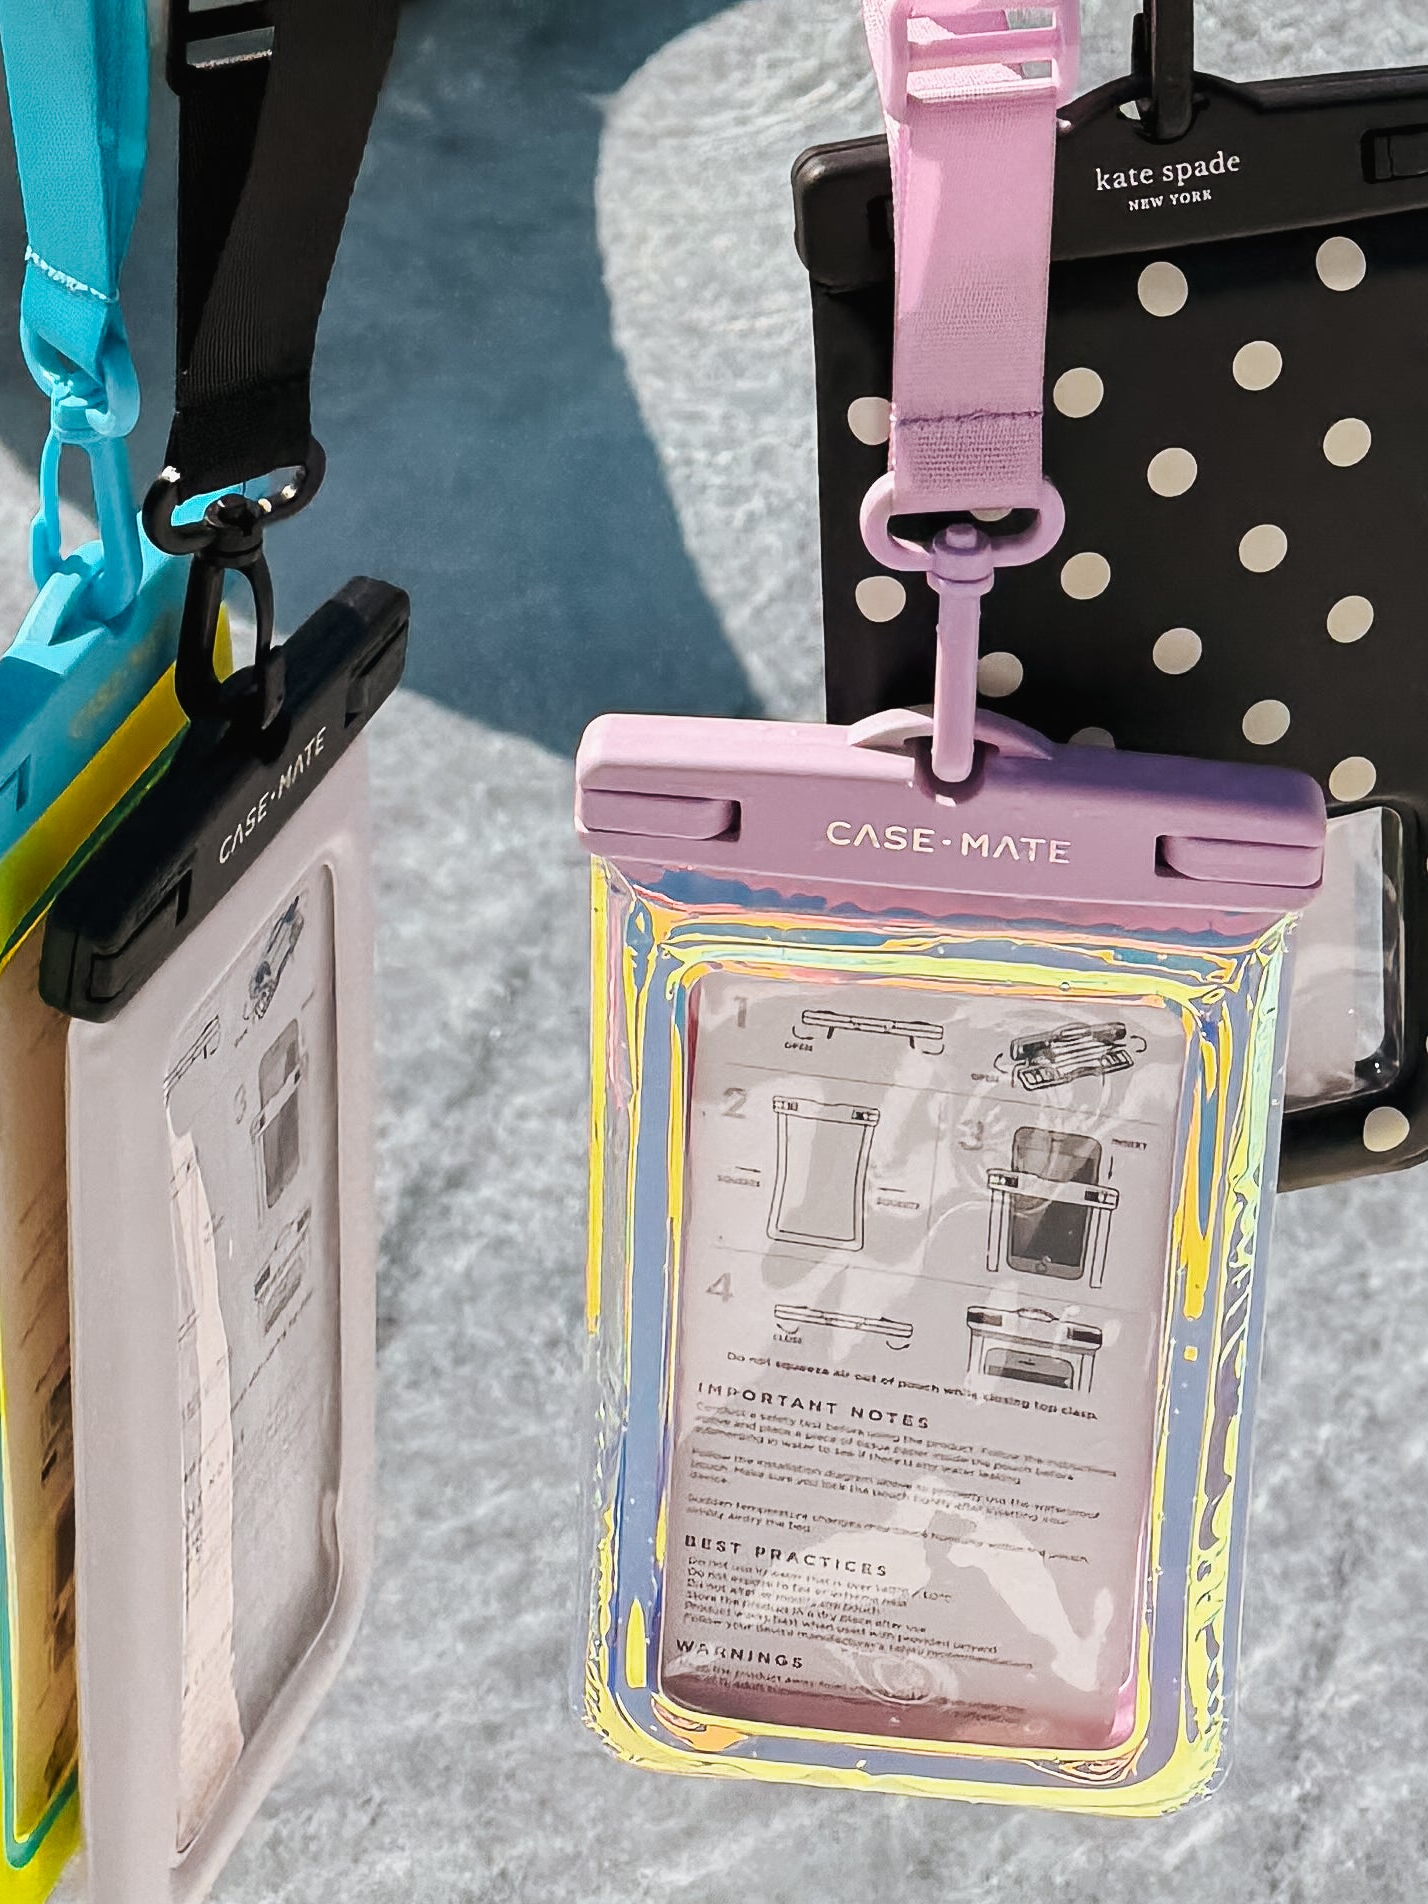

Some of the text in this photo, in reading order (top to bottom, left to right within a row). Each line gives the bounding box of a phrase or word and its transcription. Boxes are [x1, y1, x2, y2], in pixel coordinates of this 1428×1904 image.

[1095, 150, 1241, 191] kate spade
[1128, 189, 1212, 212] NEW YORK
[727, 1352, 745, 1361] Do
[699, 1383, 928, 1429] IMPORTANT NOTES
[685, 1535, 886, 1576] BEST PRACTICES
[677, 1640, 802, 1669] WARNINGS
